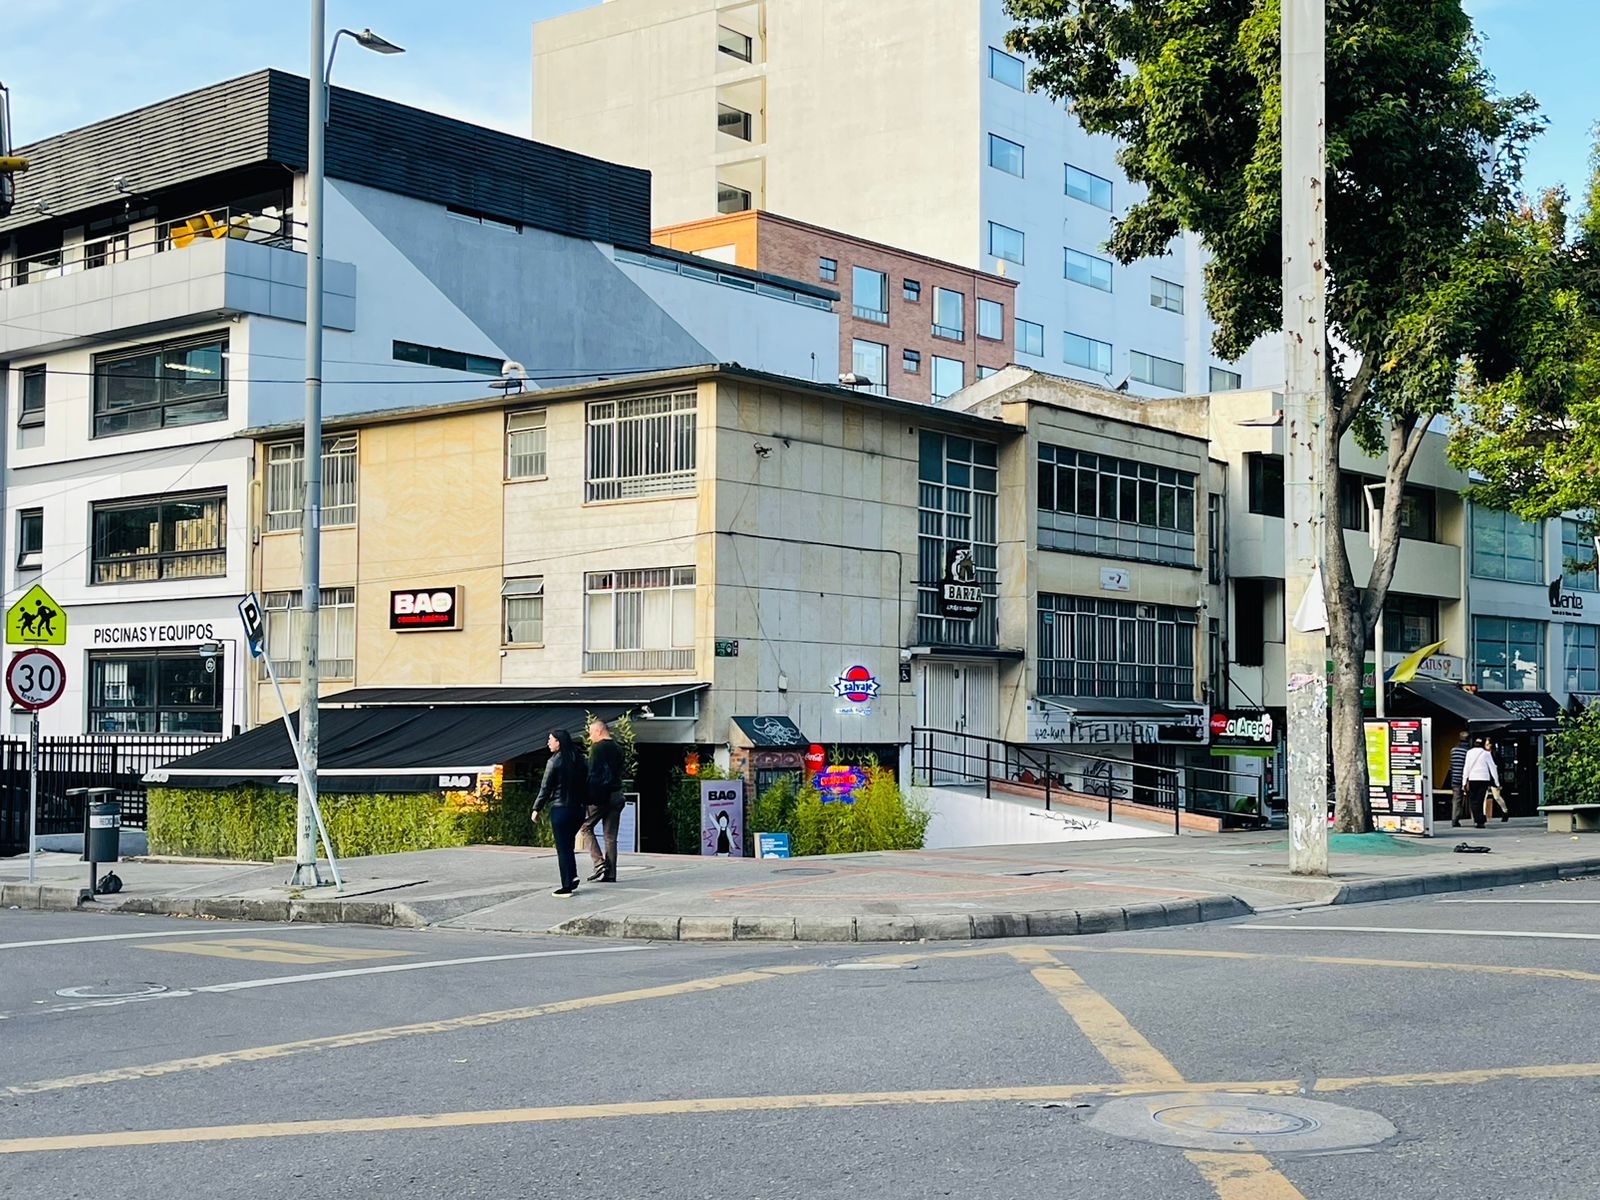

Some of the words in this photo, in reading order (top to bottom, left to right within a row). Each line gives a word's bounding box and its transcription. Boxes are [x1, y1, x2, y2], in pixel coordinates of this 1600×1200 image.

[949, 586, 982, 601] BARZA
[394, 592, 452, 614] BAO
[244, 603, 258, 637] P
[94, 626, 147, 644] PISCINAS
[149, 627, 157, 641] Y
[159, 623, 213, 641] EQUIPOS
[18, 664, 55, 692] 30
[844, 681, 873, 692] salvaje
[439, 775, 471, 787] BAO
[708, 790, 737, 800] BAO
